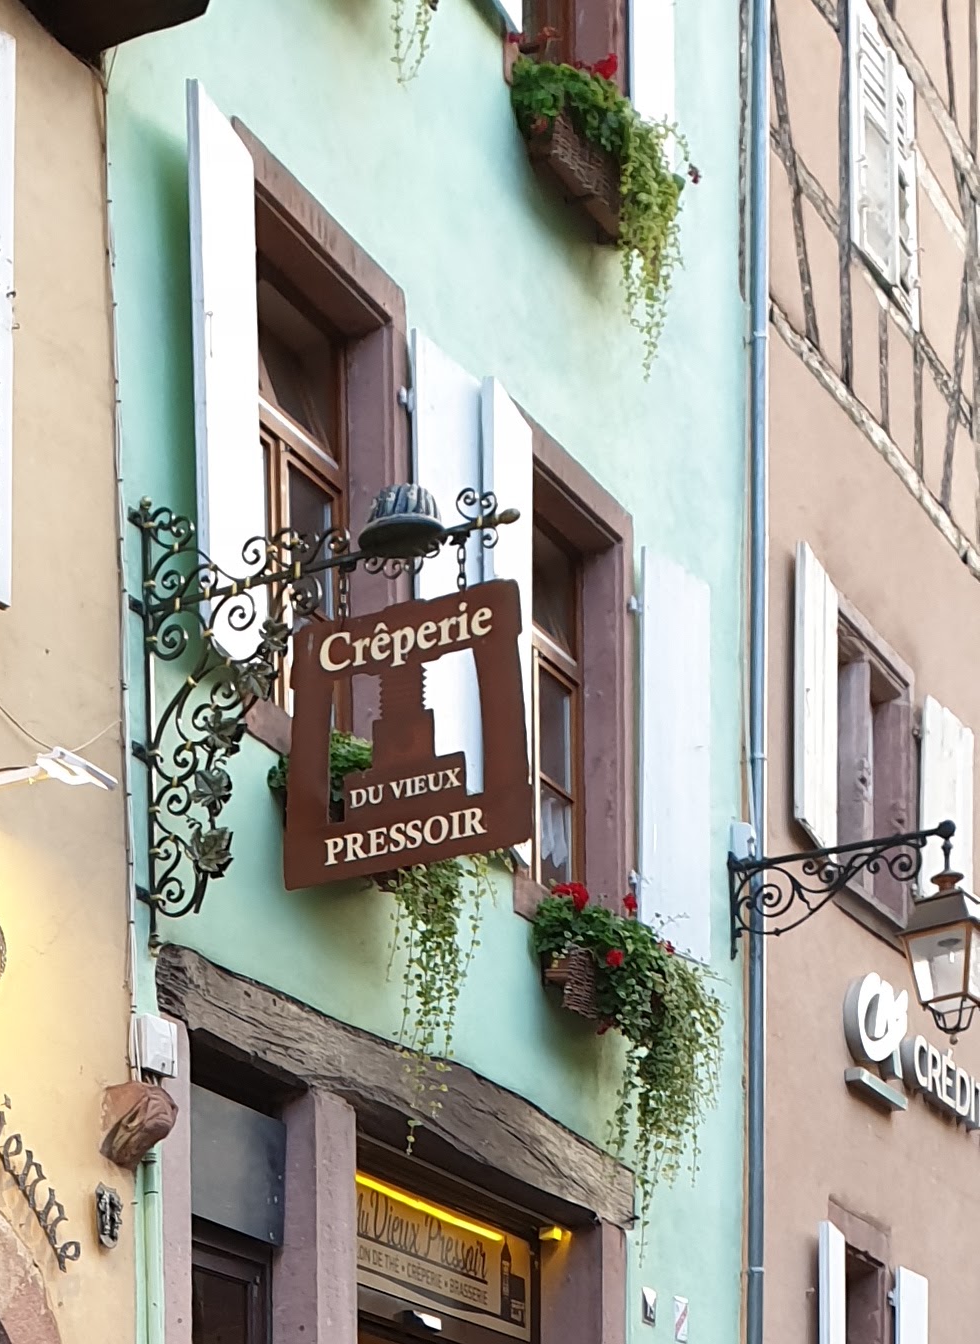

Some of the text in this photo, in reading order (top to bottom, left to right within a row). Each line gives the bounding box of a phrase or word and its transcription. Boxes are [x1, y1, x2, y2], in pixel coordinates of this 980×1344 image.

[319, 602, 493, 673] Crêperie
[349, 767, 462, 809] DU VIEUX
[324, 806, 488, 866] PRESSOIR
[912, 1034, 980, 1128] CRÉDI
[370, 1190, 421, 1256] Vieux
[424, 1214, 488, 1280] Pressoir
[449, 1277, 488, 1306] BRASSERIE
